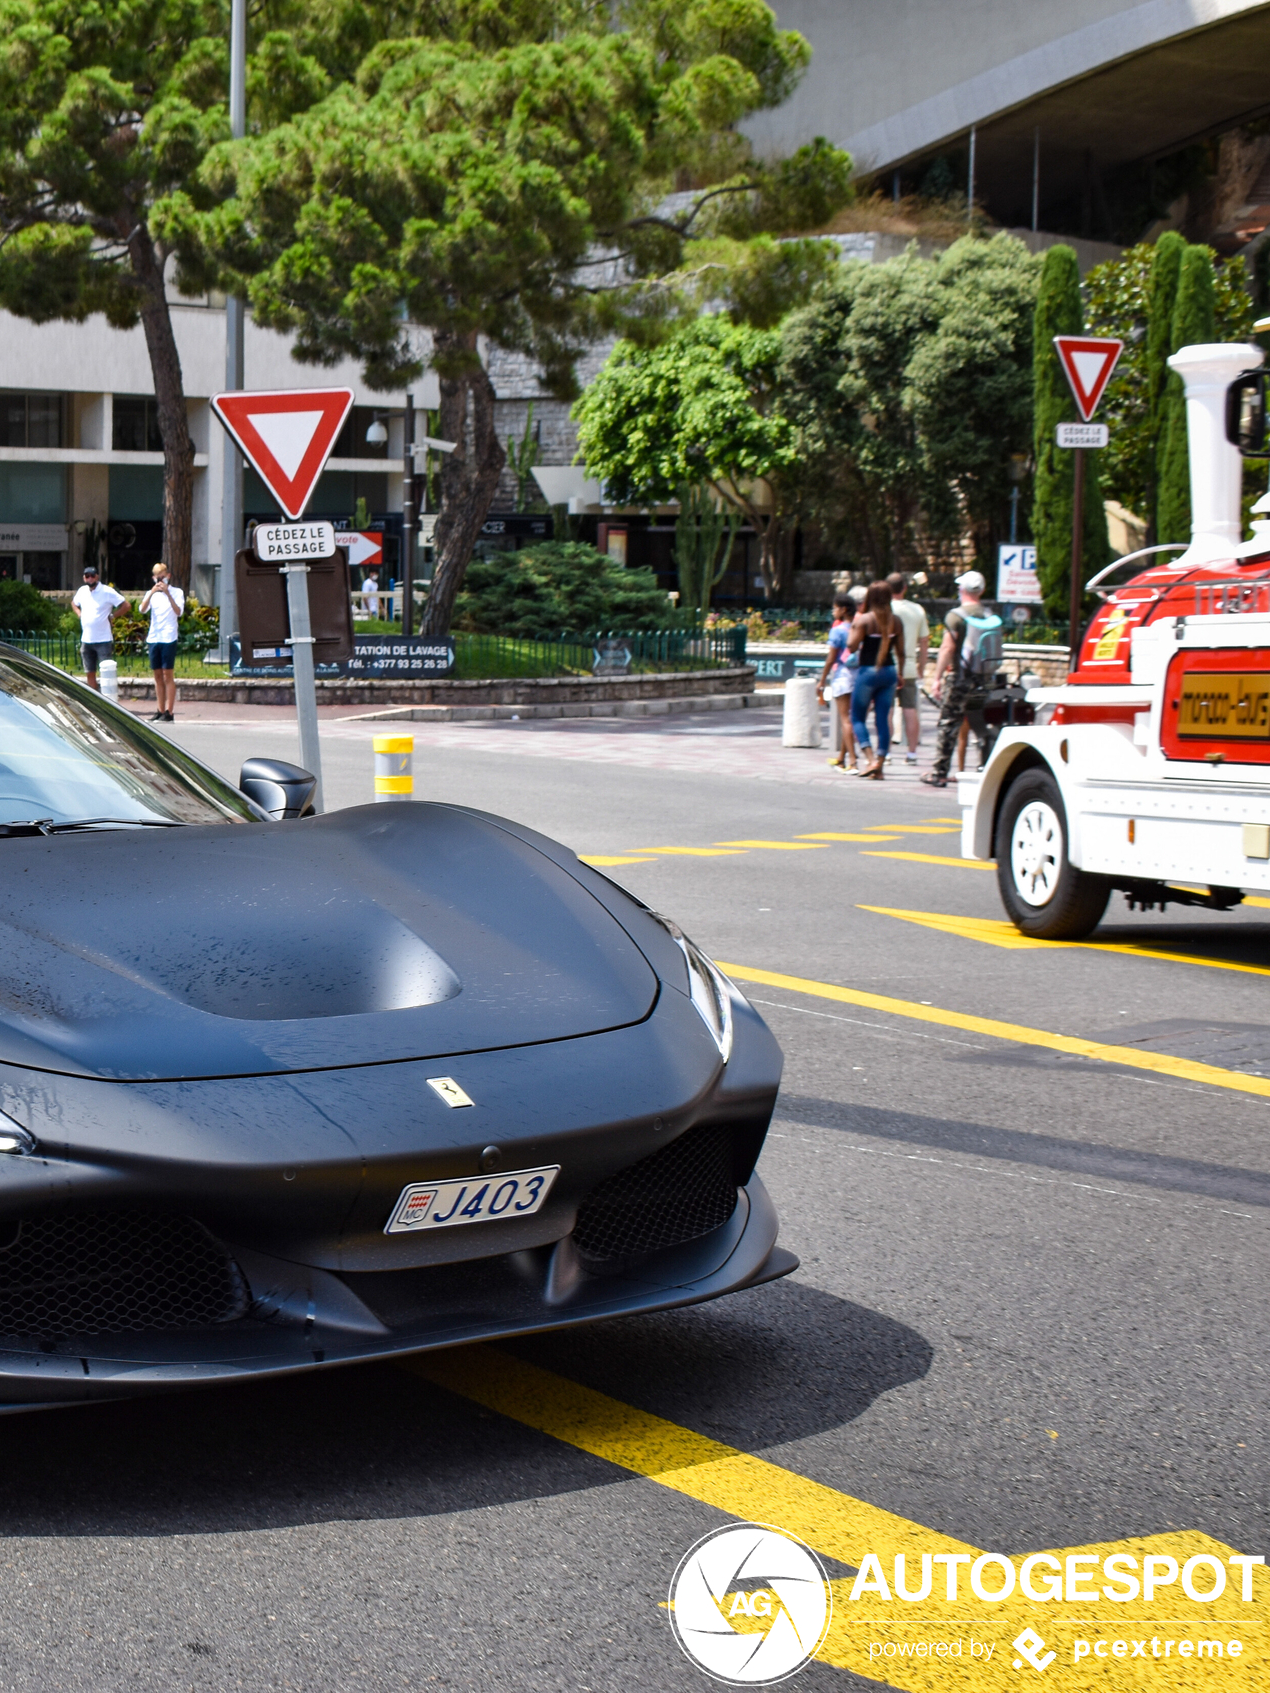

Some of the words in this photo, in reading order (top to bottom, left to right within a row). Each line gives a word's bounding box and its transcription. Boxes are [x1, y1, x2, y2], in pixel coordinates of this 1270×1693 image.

[267, 527, 307, 541] CÉDEZ
[310, 527, 325, 539] LE
[268, 541, 326, 555] PASSAGE
[392, 646, 407, 655] DE
[409, 646, 447, 656] LAVAGE
[373, 660, 396, 669] +377
[397, 660, 410, 669] 93
[411, 660, 423, 669] 25
[432, 1175, 545, 1223] J403
[403, 1208, 424, 1220] MC
